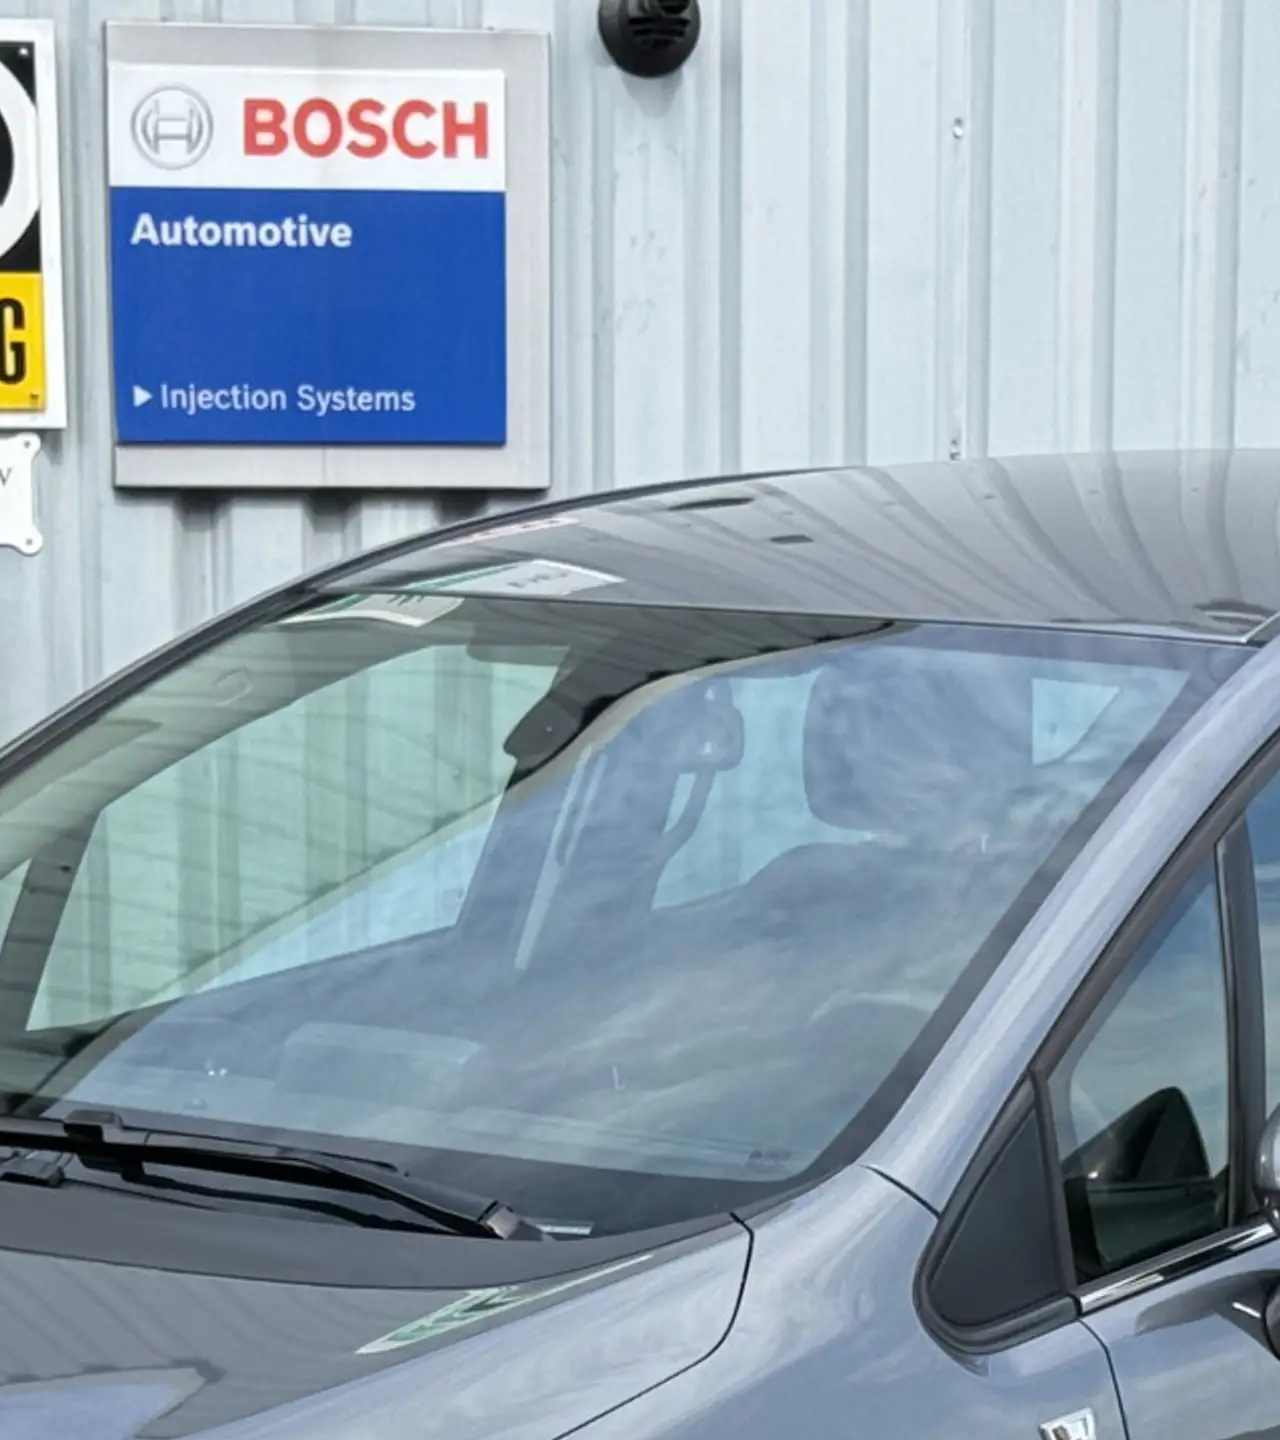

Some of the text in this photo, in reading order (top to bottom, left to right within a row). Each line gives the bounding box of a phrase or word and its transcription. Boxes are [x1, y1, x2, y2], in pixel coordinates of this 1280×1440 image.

[242, 97, 490, 160] BOSCH
[131, 212, 353, 248] Automotive
[160, 383, 417, 413] Injection Systems
